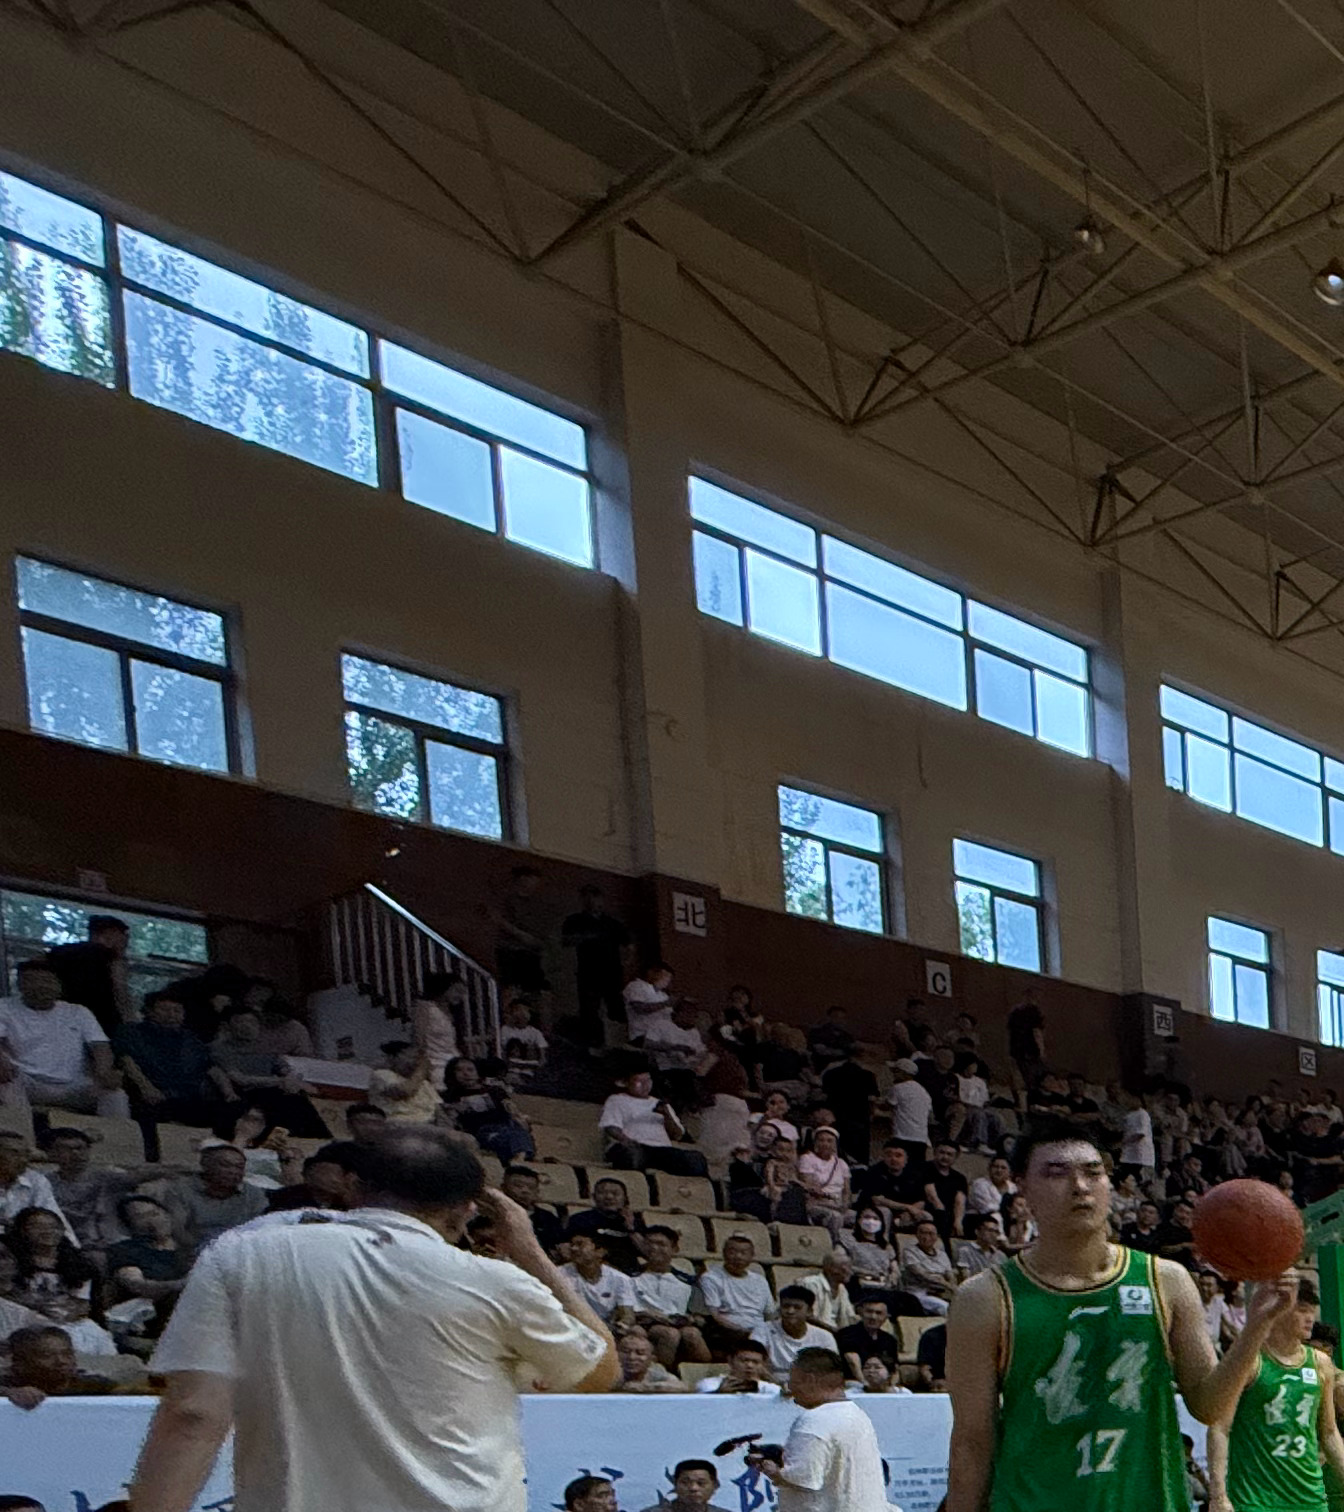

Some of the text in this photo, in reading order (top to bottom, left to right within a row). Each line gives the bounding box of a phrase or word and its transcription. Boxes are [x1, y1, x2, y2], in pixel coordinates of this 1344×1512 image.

[676, 901, 706, 928] 北
[932, 971, 947, 994] C
[1076, 1428, 1127, 1477] 17
[1271, 1434, 1307, 1458] 23
